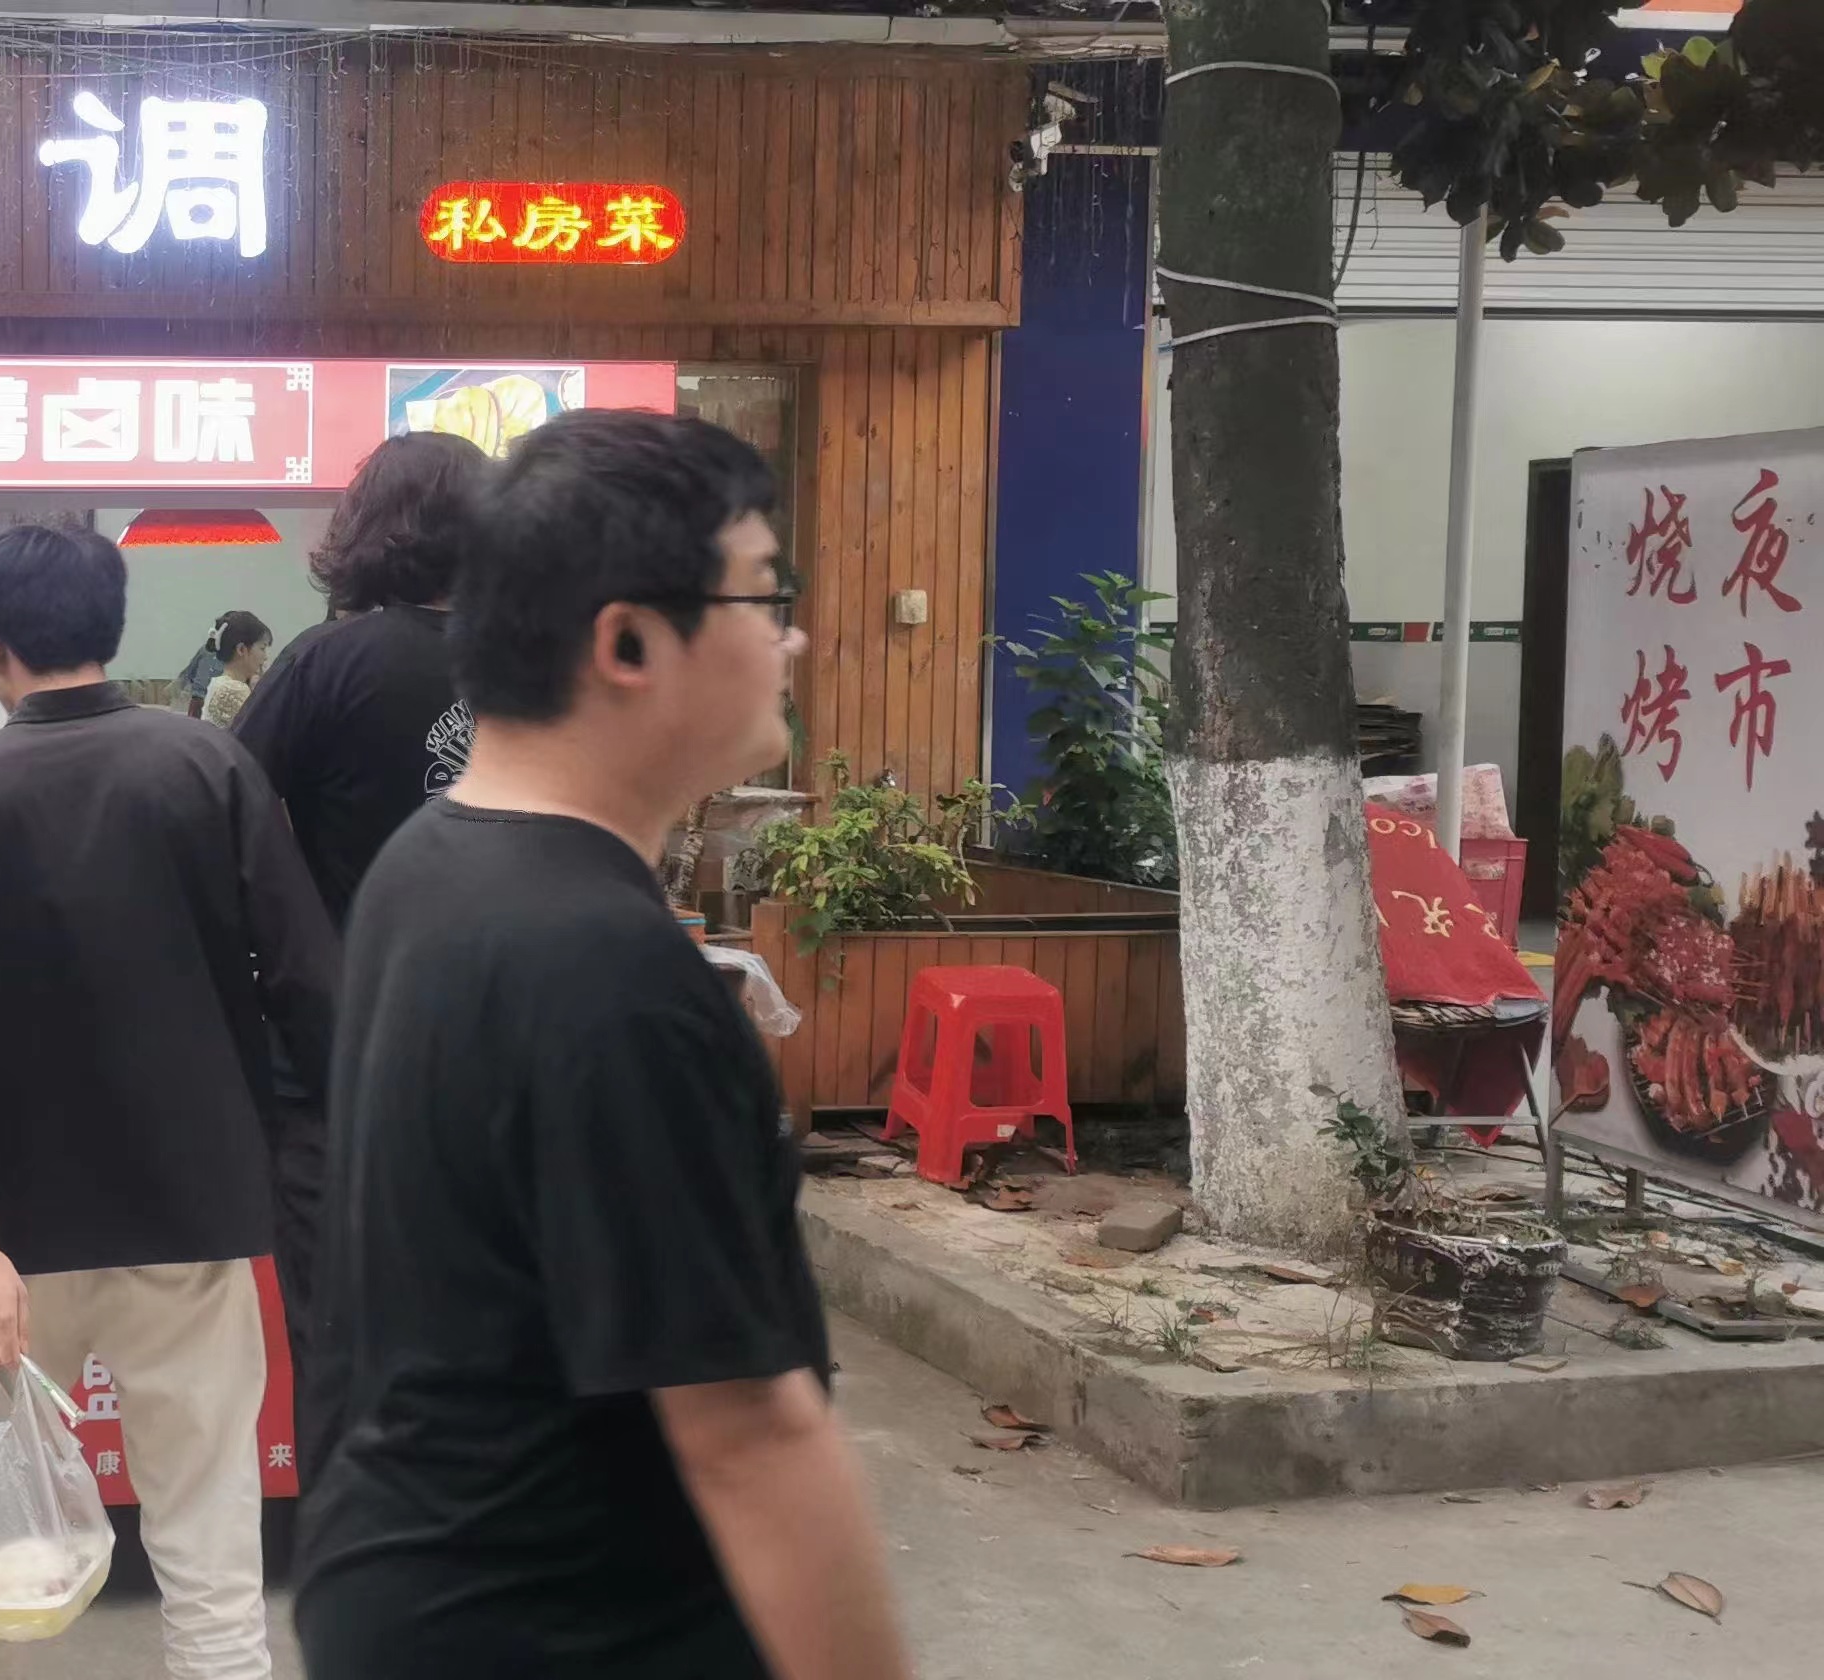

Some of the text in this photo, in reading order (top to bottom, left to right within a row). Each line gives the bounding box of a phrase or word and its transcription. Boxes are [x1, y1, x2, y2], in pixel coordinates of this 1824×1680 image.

[428, 194, 676, 252] 私房菜
[1619, 483, 1698, 784] 烧烤
[1715, 466, 1804, 793] 夜市
[95, 1442, 293, 1477] 康 来
